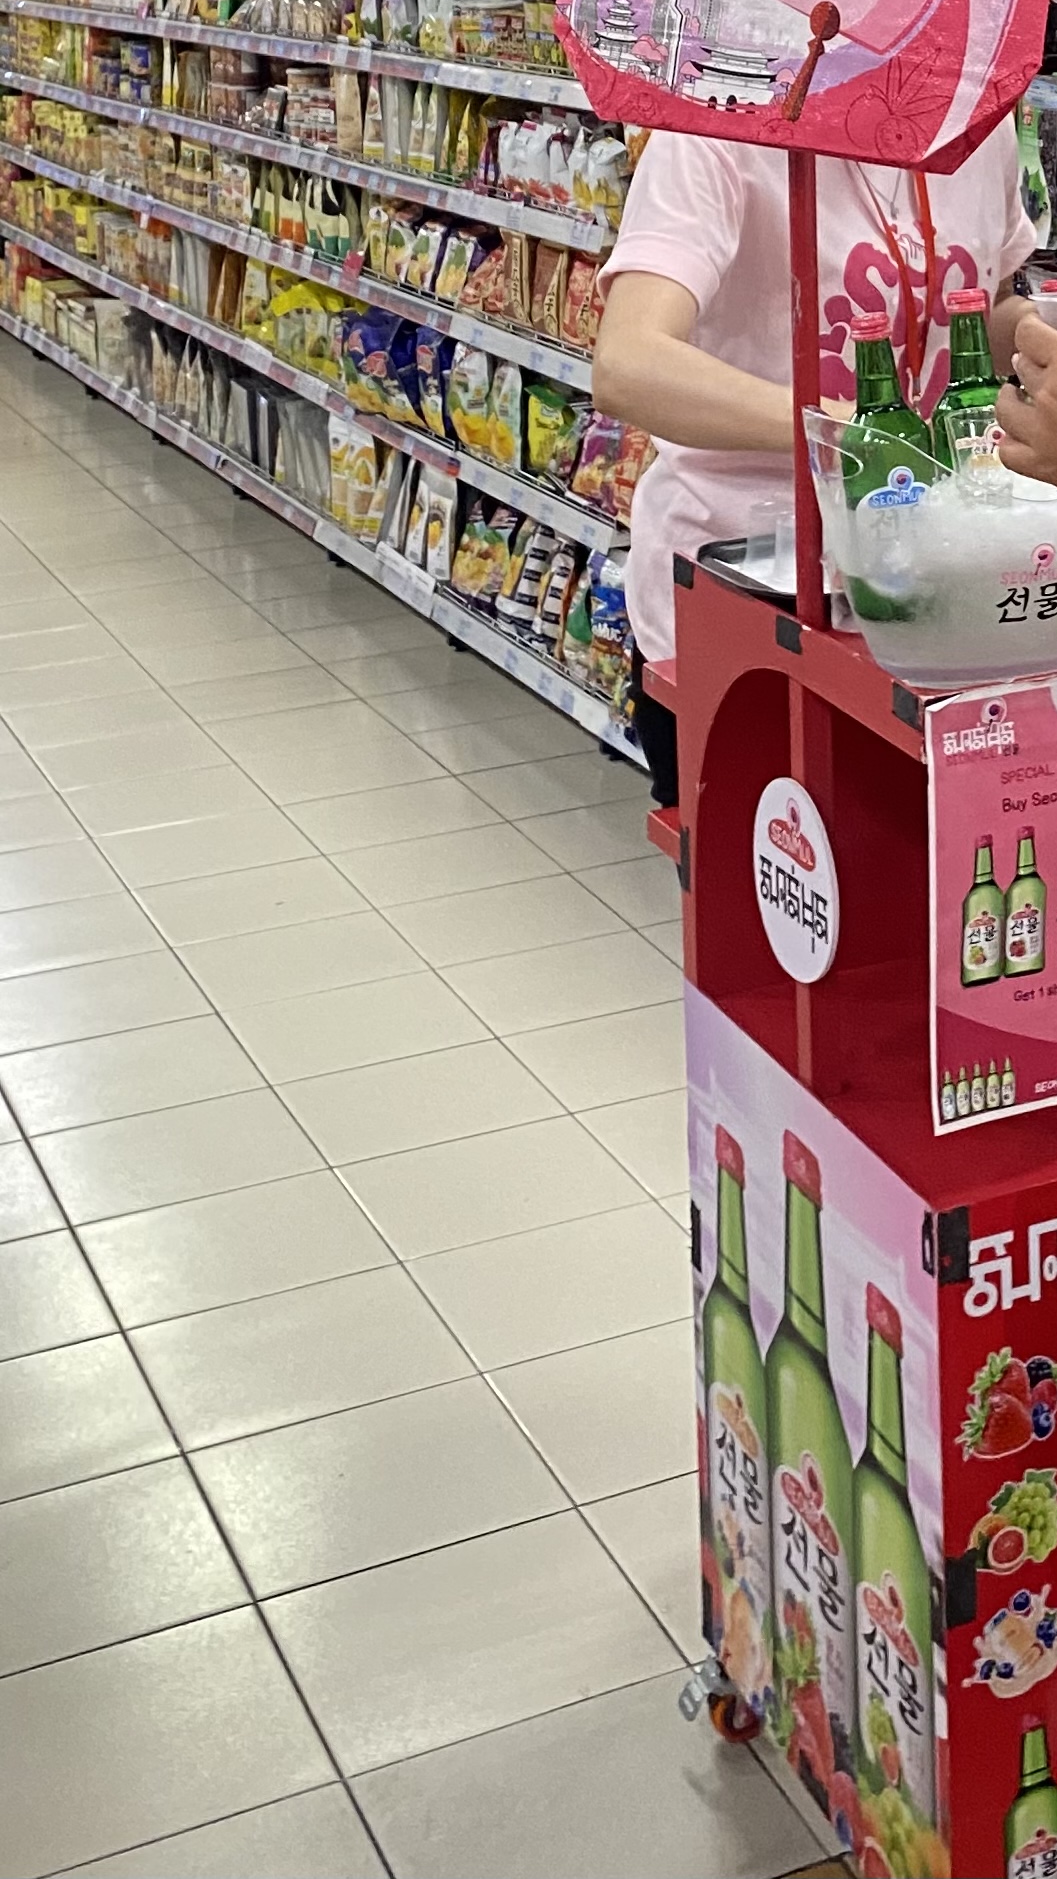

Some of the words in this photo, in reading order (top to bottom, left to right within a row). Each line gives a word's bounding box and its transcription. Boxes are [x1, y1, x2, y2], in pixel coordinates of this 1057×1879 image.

[1000, 764, 1055, 785] SPECIAL
[1002, 798, 1028, 812] Buy
[1013, 988, 1035, 1002] Get
